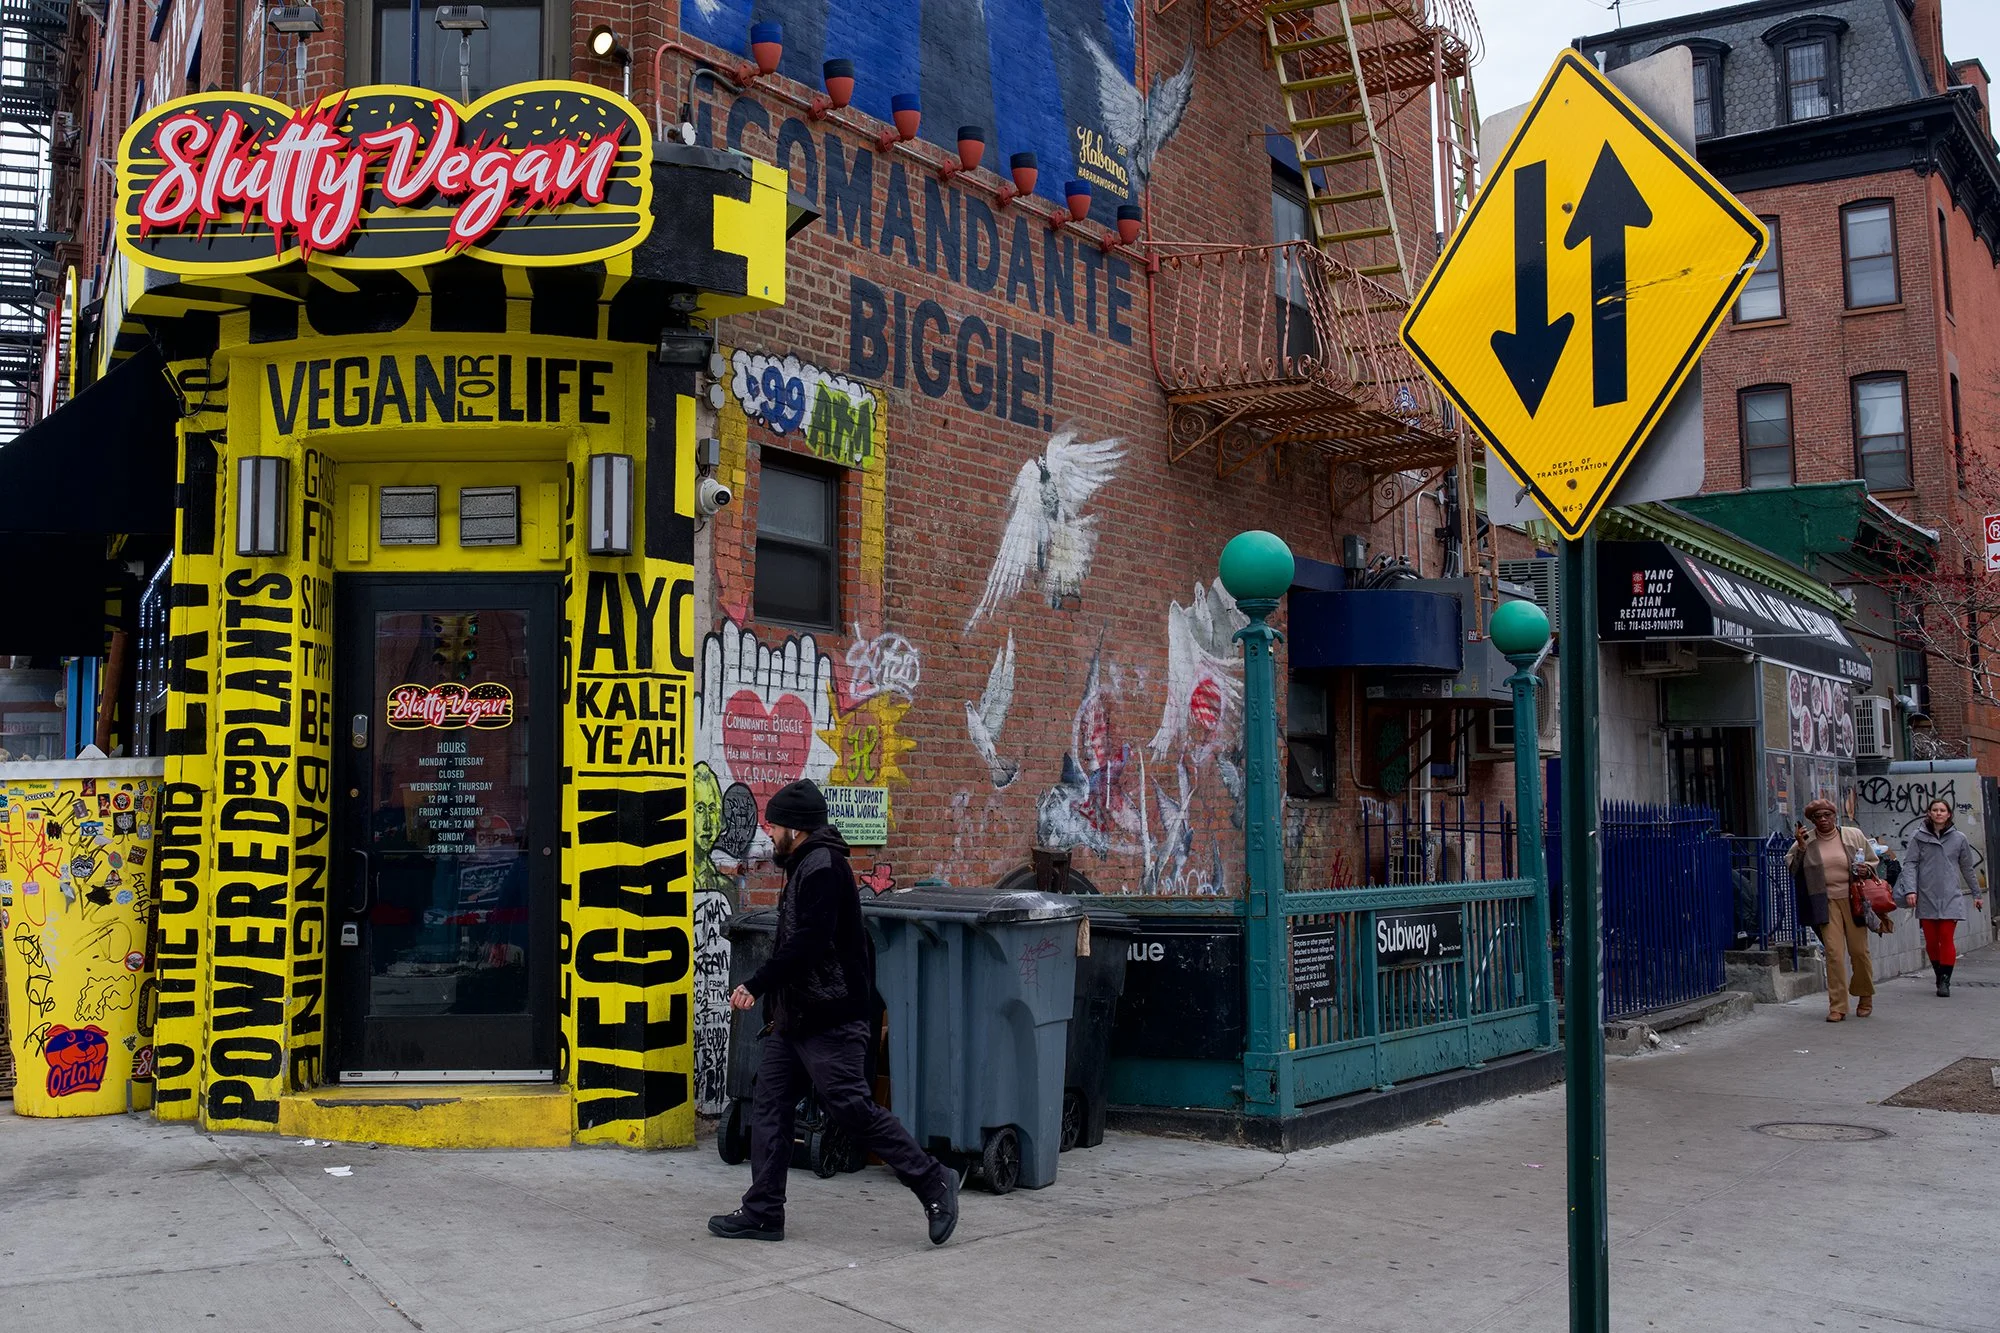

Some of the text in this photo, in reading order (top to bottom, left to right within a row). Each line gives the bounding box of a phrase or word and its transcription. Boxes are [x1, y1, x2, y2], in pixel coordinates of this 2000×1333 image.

[1076, 125, 1129, 186] Habana
[141, 99, 618, 250] Slutty Vegan
[850, 275, 1056, 432] BIGGIE!
[266, 355, 456, 436] VEGAN
[456, 353, 495, 423] FOR
[498, 353, 612, 425] LIFE
[805, 379, 876, 468] ATM
[1536, 462, 1608, 479] TRANSPORTATION
[1552, 457, 1591, 470] DEPT OF
[1562, 503, 1584, 513] W6-3
[302, 498, 334, 570] FED
[1644, 569, 1674, 581] YANG
[1647, 582, 1672, 594] NO.1
[1631, 596, 1662, 607] ASIAN
[1620, 607, 1677, 619] RESTAURANT
[1614, 621, 1626, 631] TEL:
[300, 640, 332, 682] TOPPY
[394, 690, 507, 726] Slutty Vegan
[576, 681, 677, 721] KALE
[300, 689, 331, 745] BE
[725, 711, 804, 734] COMANDANTE BIGGIE
[752, 733, 778, 743] AND THE
[437, 742, 467, 754] HOURS
[727, 745, 790, 762] HABANA FAMILY SAY
[418, 758, 448, 767] MONDAY
[454, 757, 485, 767] TUESDAY
[438, 769, 465, 779] CLOSED
[409, 783, 452, 792] WEDNESDAY
[458, 782, 494, 791] THURSDAY
[427, 795, 436, 804] 12
[437, 795, 448, 804] PM
[455, 795, 463, 804] 10
[464, 794, 476, 804] PM
[823, 788, 884, 804] ATM FEE SUPPORT
[418, 808, 443, 817] FRIDAY
[449, 807, 485, 817] SATURDAY
[428, 820, 437, 829] 12
[454, 820, 462, 829] 12
[463, 820, 475, 829] AM
[437, 832, 465, 842] SUNDAY
[208, 568, 293, 1125] POWERED BY PLANTS
[427, 845, 436, 854] 12
[437, 845, 448, 854] PM
[455, 845, 463, 854] 10
[464, 845, 476, 854] PM
[1377, 919, 1431, 956] Subway
[574, 786, 691, 1130] VEGAN
